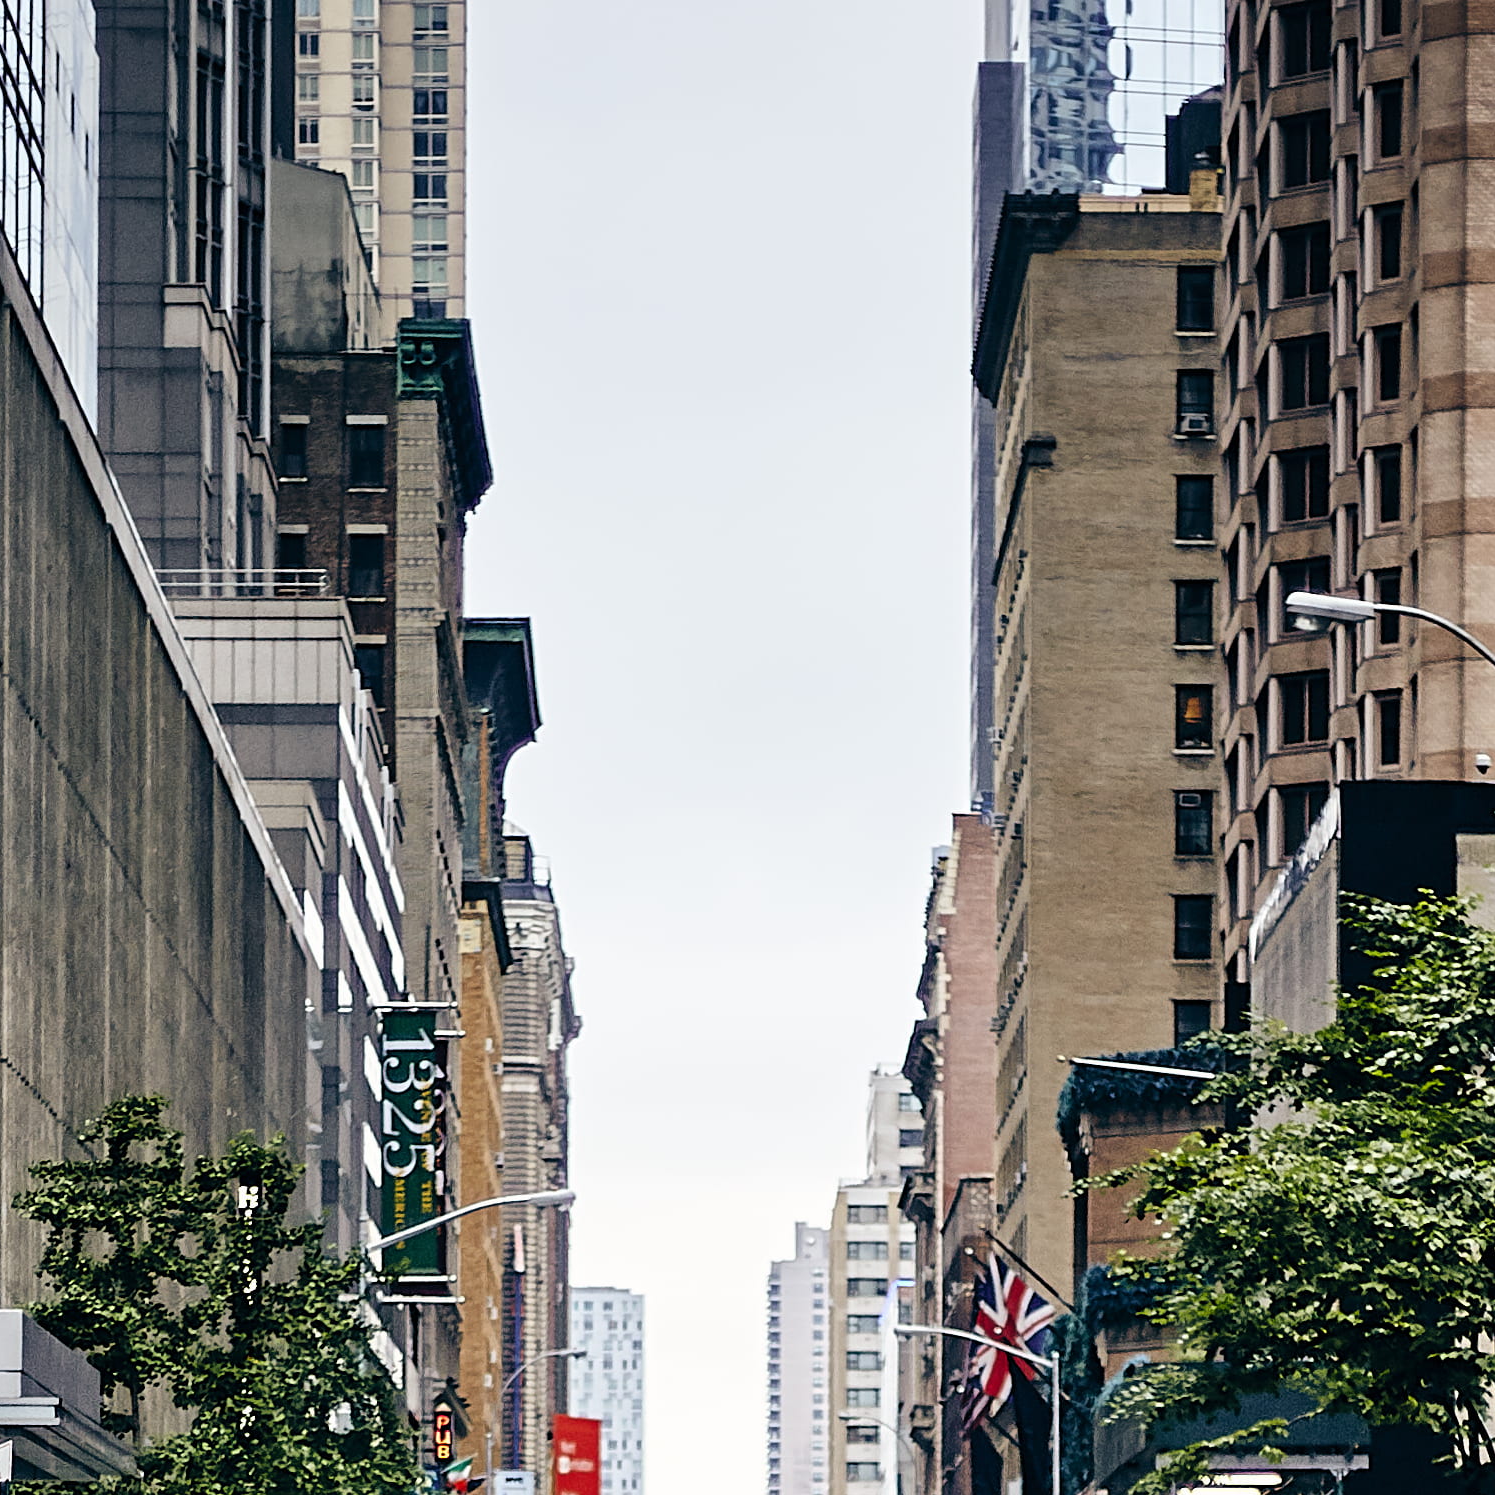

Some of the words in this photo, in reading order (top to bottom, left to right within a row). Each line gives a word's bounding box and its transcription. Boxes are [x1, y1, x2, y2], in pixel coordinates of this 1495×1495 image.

[382, 1028, 436, 1178] 1325
[420, 1181, 434, 1214] THE
[435, 1414, 451, 1460] PUB
